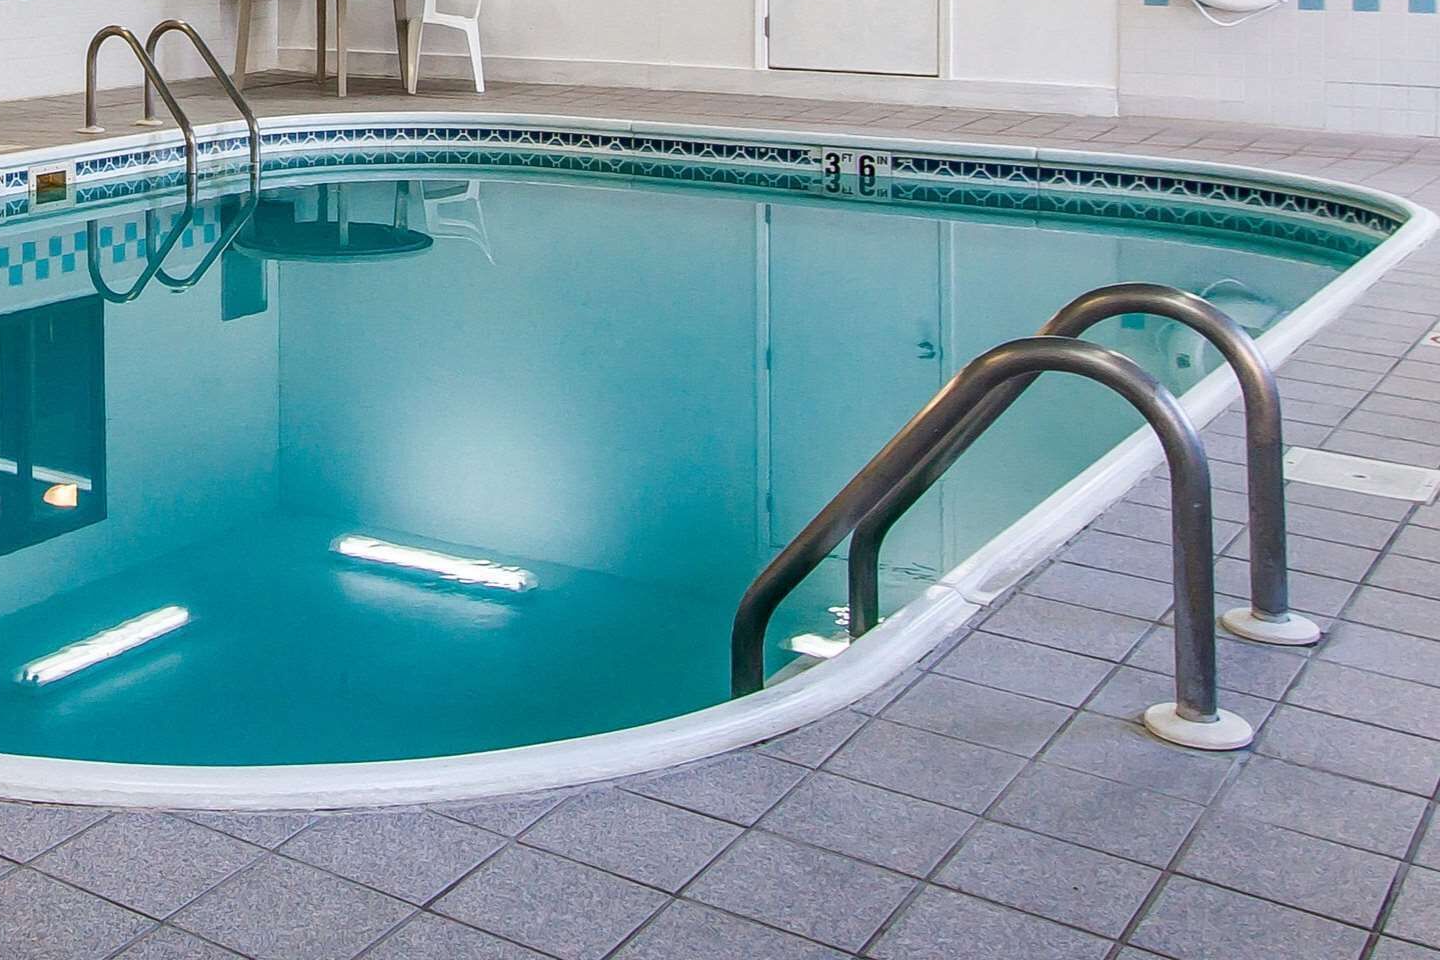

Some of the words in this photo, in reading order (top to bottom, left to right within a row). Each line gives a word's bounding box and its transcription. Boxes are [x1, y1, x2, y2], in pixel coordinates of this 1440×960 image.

[825, 152, 840, 175] 3
[841, 153, 853, 162] FT
[859, 154, 875, 176] 6
[877, 156, 888, 165] IN
